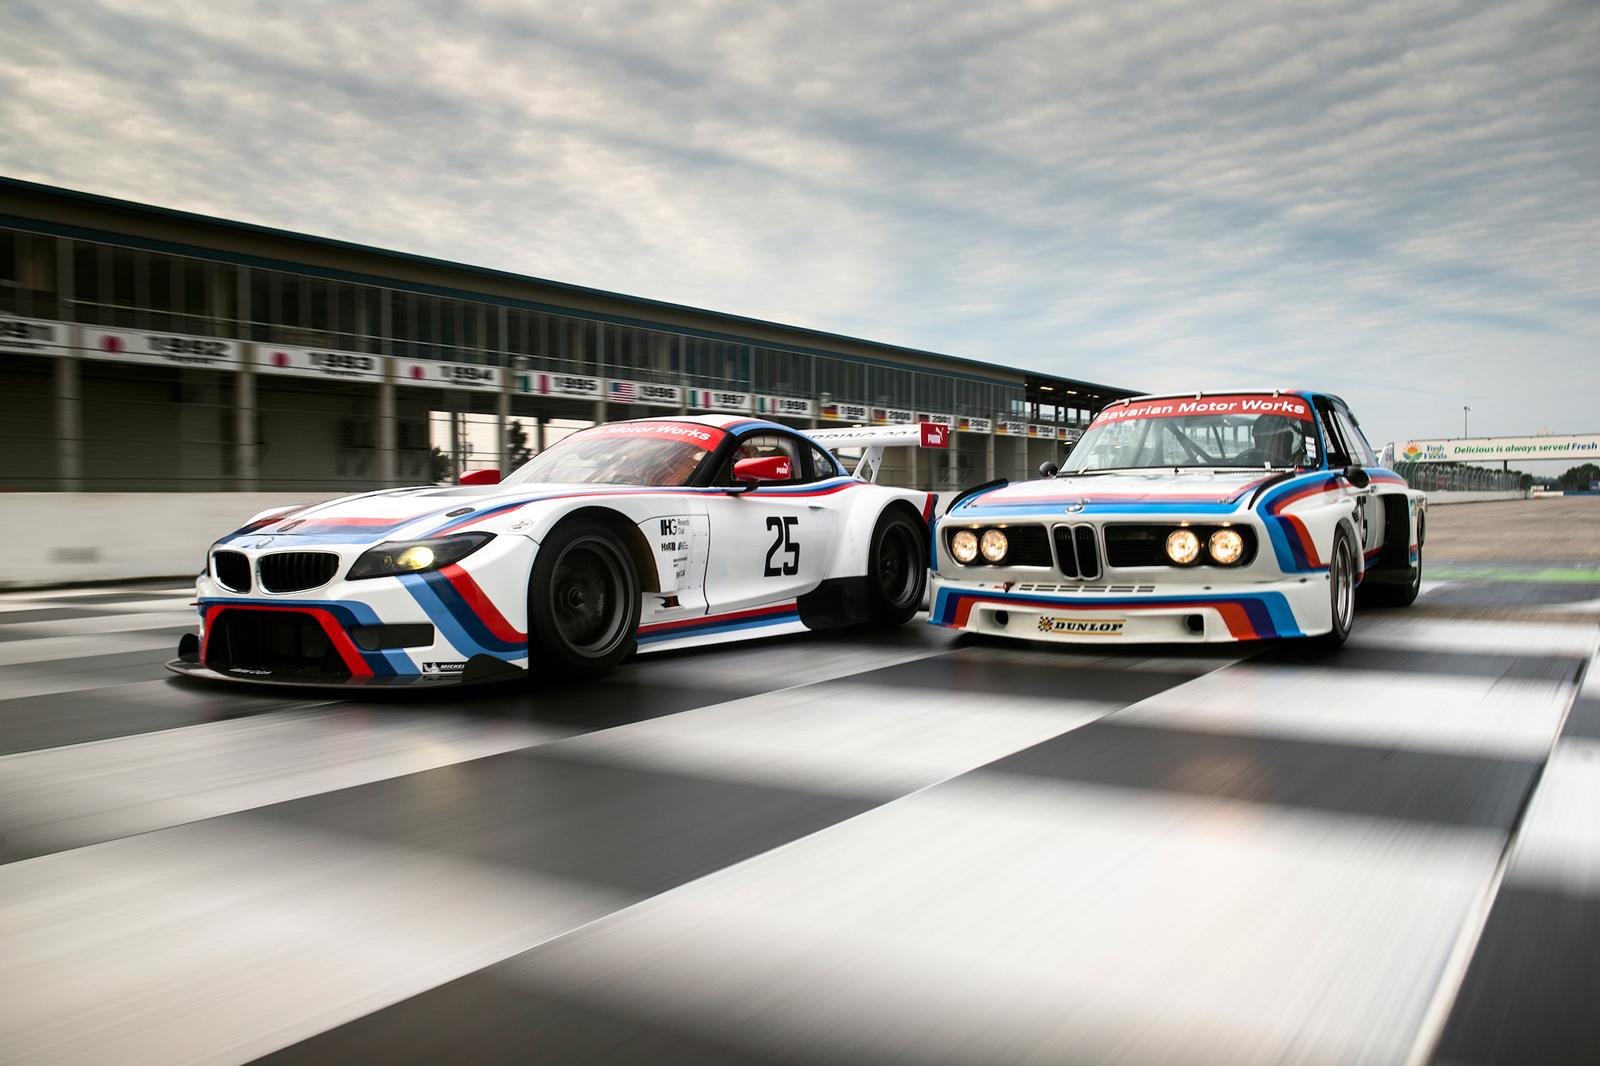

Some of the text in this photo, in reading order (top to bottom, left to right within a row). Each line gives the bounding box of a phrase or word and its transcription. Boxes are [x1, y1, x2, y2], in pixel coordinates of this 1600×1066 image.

[146, 335, 230, 357] 1992
[308, 352, 374, 371] 1993
[441, 366, 494, 381] 1994
[553, 376, 598, 391] 1995
[640, 385, 677, 399] 1996
[714, 393, 746, 405] 1997
[779, 399, 808, 411] 1998
[841, 406, 866, 416] 1999
[1097, 399, 1306, 423] Bavarian Motor Works
[888, 411, 912, 420] 2000
[971, 419, 990, 428] 2002
[655, 425, 711, 440] Works
[1454, 441, 1598, 454] Delicious is always served Fresh
[660, 518, 677, 536] IHG
[764, 516, 800, 577] 25
[1055, 621, 1124, 632] DUNLOP
